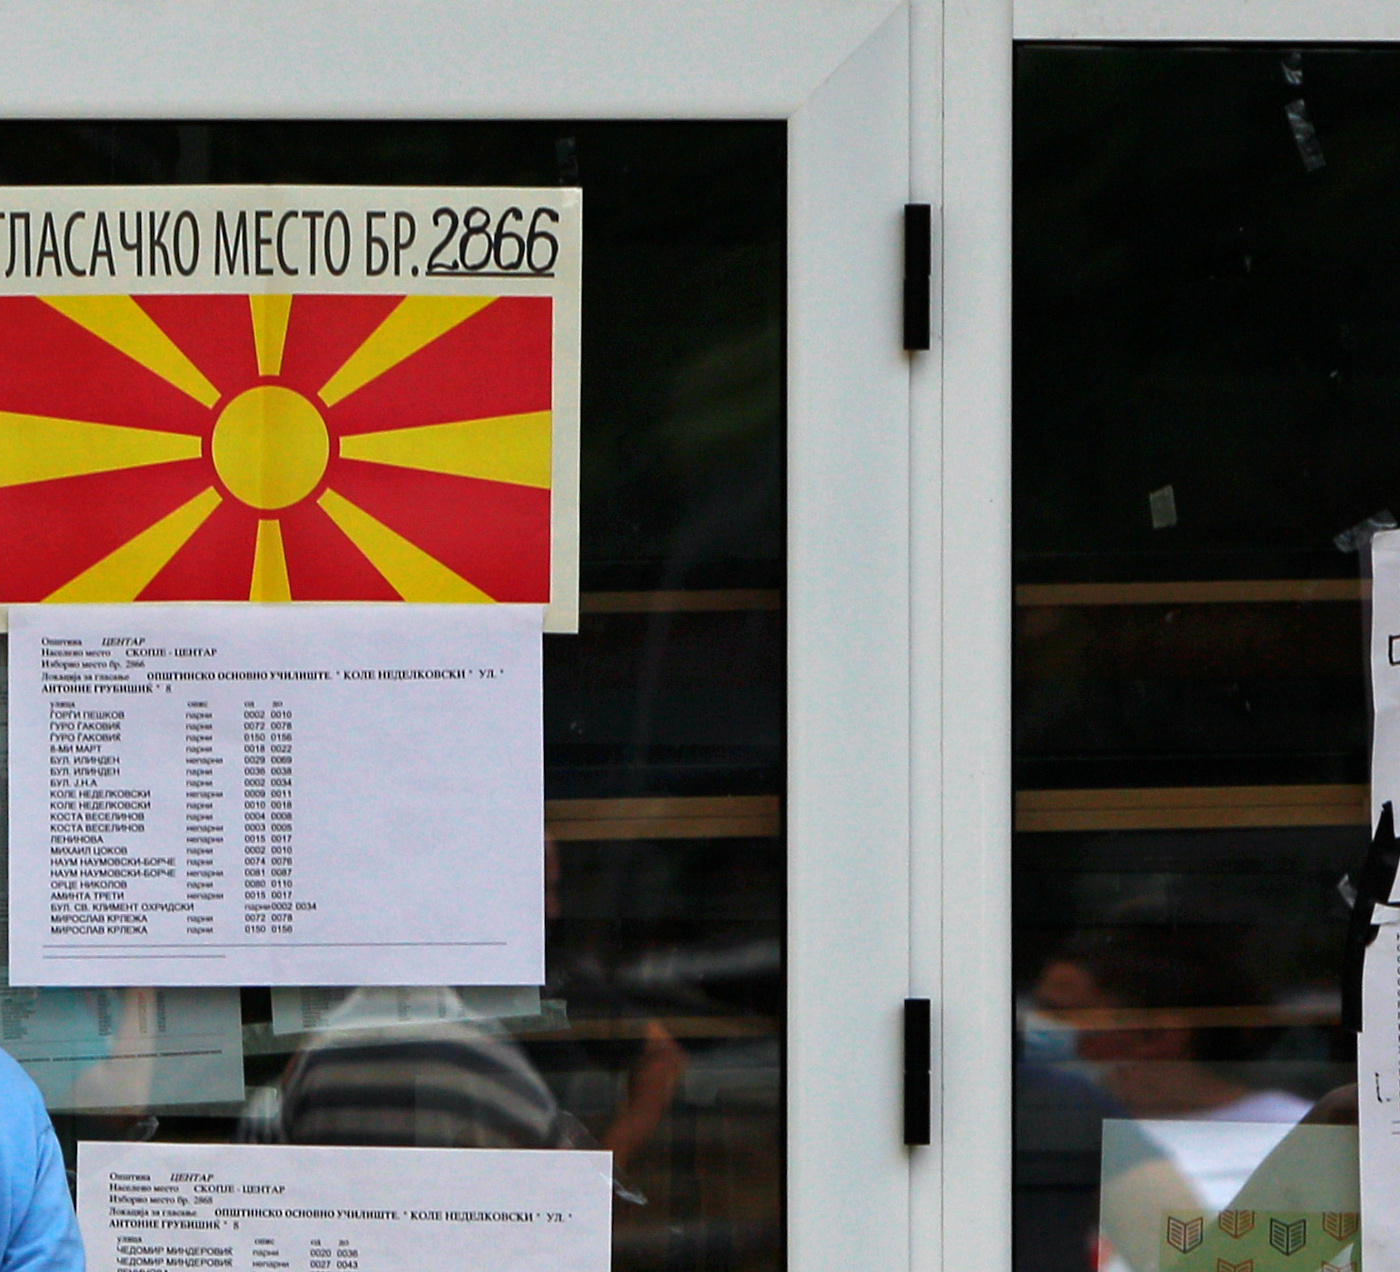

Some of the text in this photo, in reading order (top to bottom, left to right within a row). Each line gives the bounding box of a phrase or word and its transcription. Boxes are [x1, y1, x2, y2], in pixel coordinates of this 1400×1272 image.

[215, 210, 350, 276] МЕСТО
[367, 211, 418, 277] БР.
[427, 207, 559, 272] 2866
[102, 638, 145, 647] ЦЕНТАР
[175, 649, 217, 657] ЦЕНТАР
[147, 672, 215, 680] ОПШТИНСКО
[217, 672, 268, 680] ОСНОВНО
[344, 671, 375, 680] КОЛЕ
[378, 670, 465, 680] НЕДЕЛКОВСКИ
[42, 684, 91, 693] АНТОНИЕ
[51, 835, 104, 844] ЛЕНИНОВА
[170, 1173, 214, 1183] ЦЕНТАР
[243, 1185, 285, 1194] ЦЕНТАР
[215, 1208, 283, 1218] ОПШТИНСКО
[285, 1209, 335, 1218] ОСНОВНО
[411, 1211, 442, 1220] КОЛЕ
[445, 1211, 533, 1223] НЕДЕЛКОВСКИ
[109, 1219, 159, 1228] АНТОНИЕ
